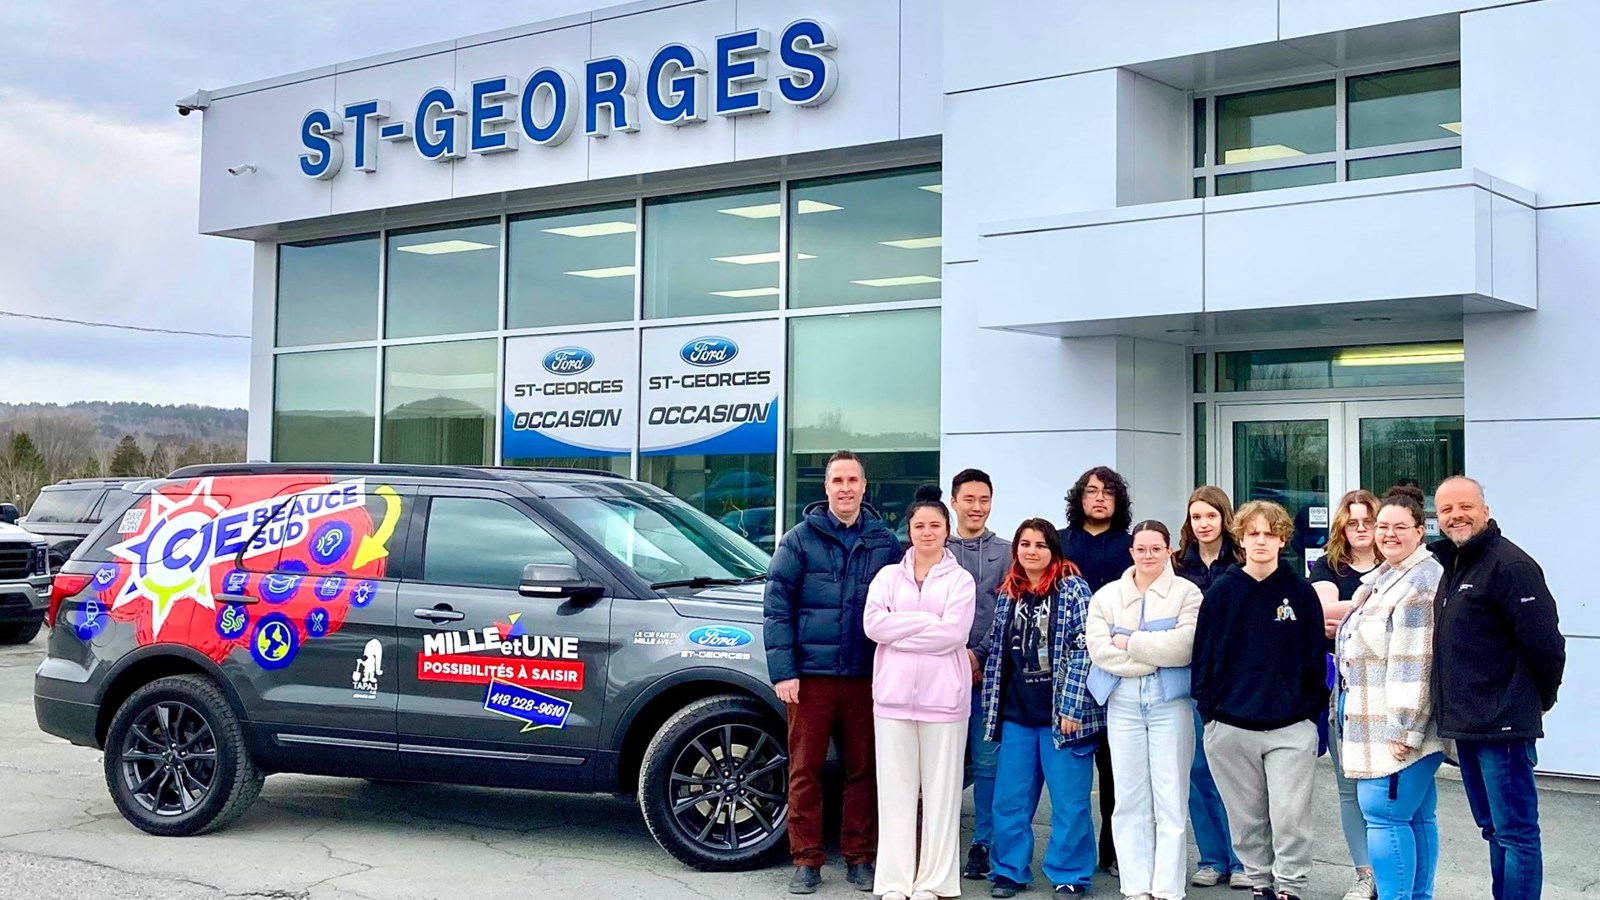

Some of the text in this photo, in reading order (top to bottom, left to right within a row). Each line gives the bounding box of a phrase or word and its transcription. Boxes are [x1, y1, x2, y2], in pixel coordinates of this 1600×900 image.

[299, 19, 836, 180] ST-GEORGES
[551, 350, 585, 371] Ford
[690, 340, 728, 361] Ford
[514, 380, 624, 397] ST-GEORGES
[649, 371, 771, 390] ST-GEORGES
[513, 409, 622, 429] OCCASION
[648, 403, 770, 425] OCCASION
[253, 485, 358, 526] BEAUCE
[253, 522, 304, 550] SUD
[423, 627, 502, 657] MILLE
[681, 650, 751, 660] ST-GEORGES
[423, 661, 578, 683] POSSIBILITÉS À SAISIR
[352, 681, 378, 691] TAPAJ
[490, 693, 566, 718] 418 228-9610
